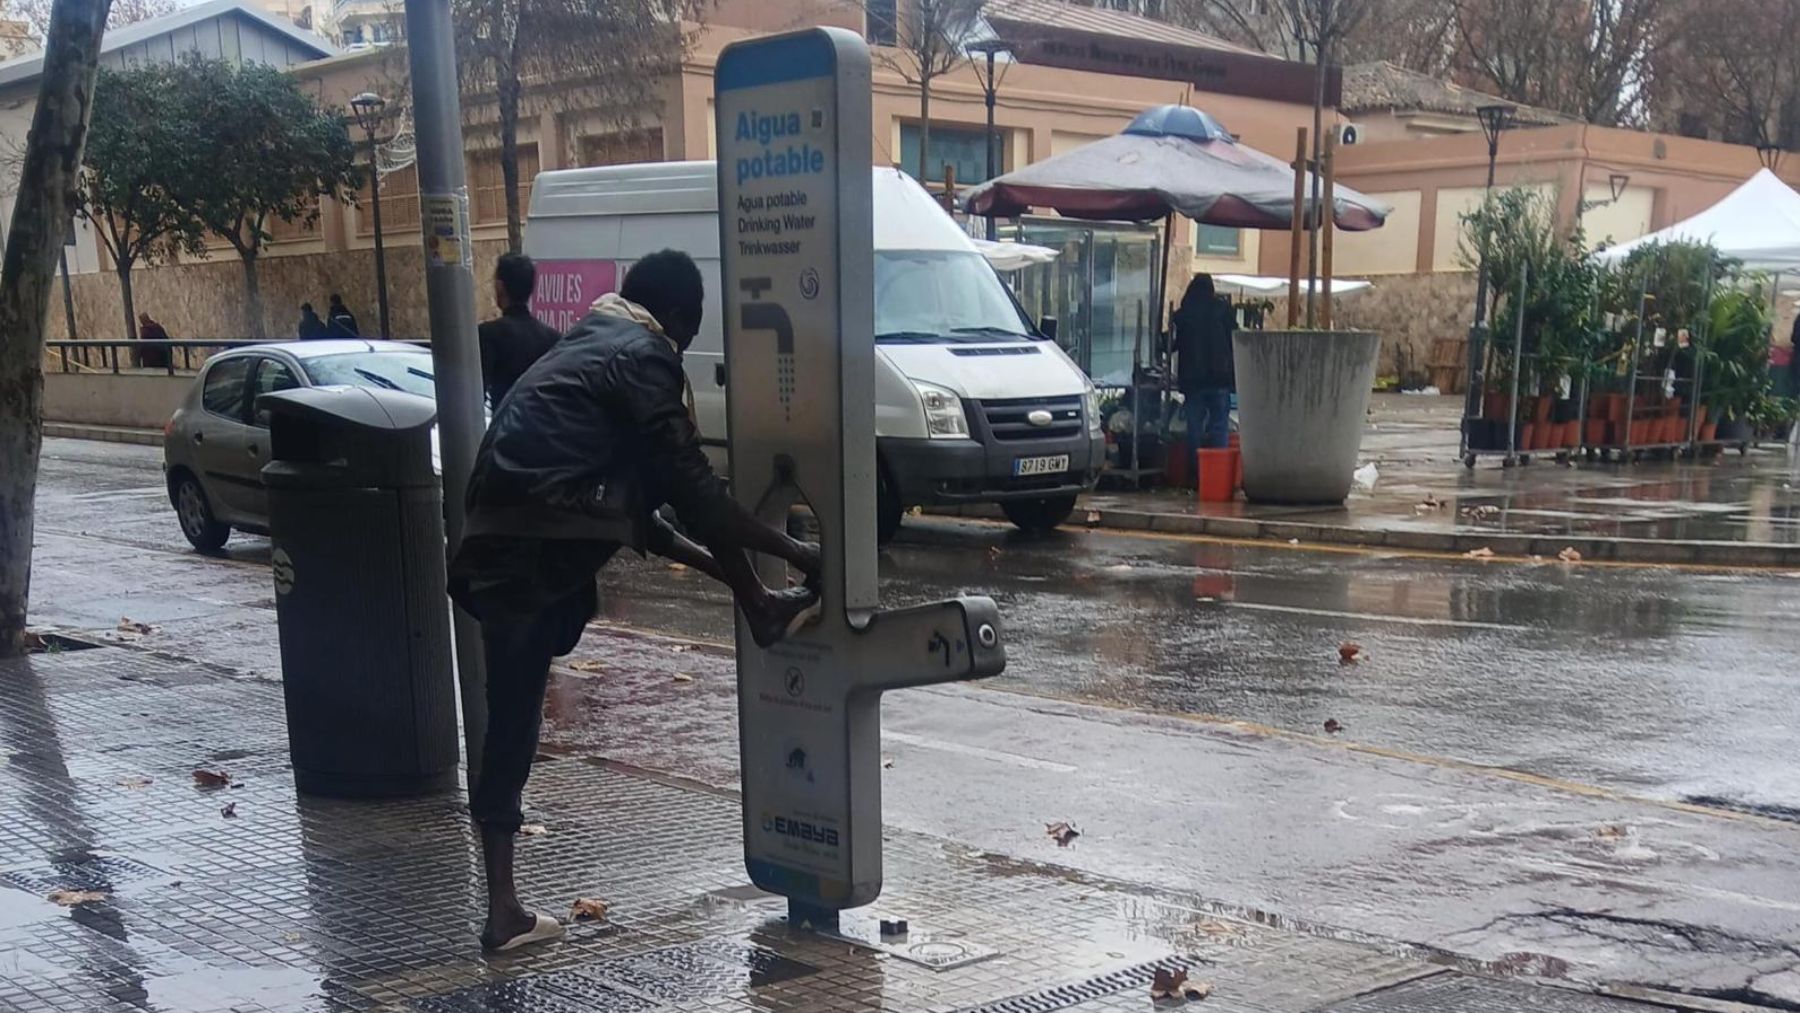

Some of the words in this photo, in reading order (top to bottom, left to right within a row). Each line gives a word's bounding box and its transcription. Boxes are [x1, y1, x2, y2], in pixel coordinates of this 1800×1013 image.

[736, 111, 801, 144] Aigua
[736, 144, 824, 185] potable
[738, 194, 764, 212] Agua
[767, 190, 808, 211] potable
[738, 214, 781, 234] Drinking
[783, 213, 816, 230] Water
[738, 238, 801, 256] Trinkwasser
[537, 273, 564, 303] AVUI
[566, 273, 583, 303] ES
[1021, 459, 1046, 473] 8719
